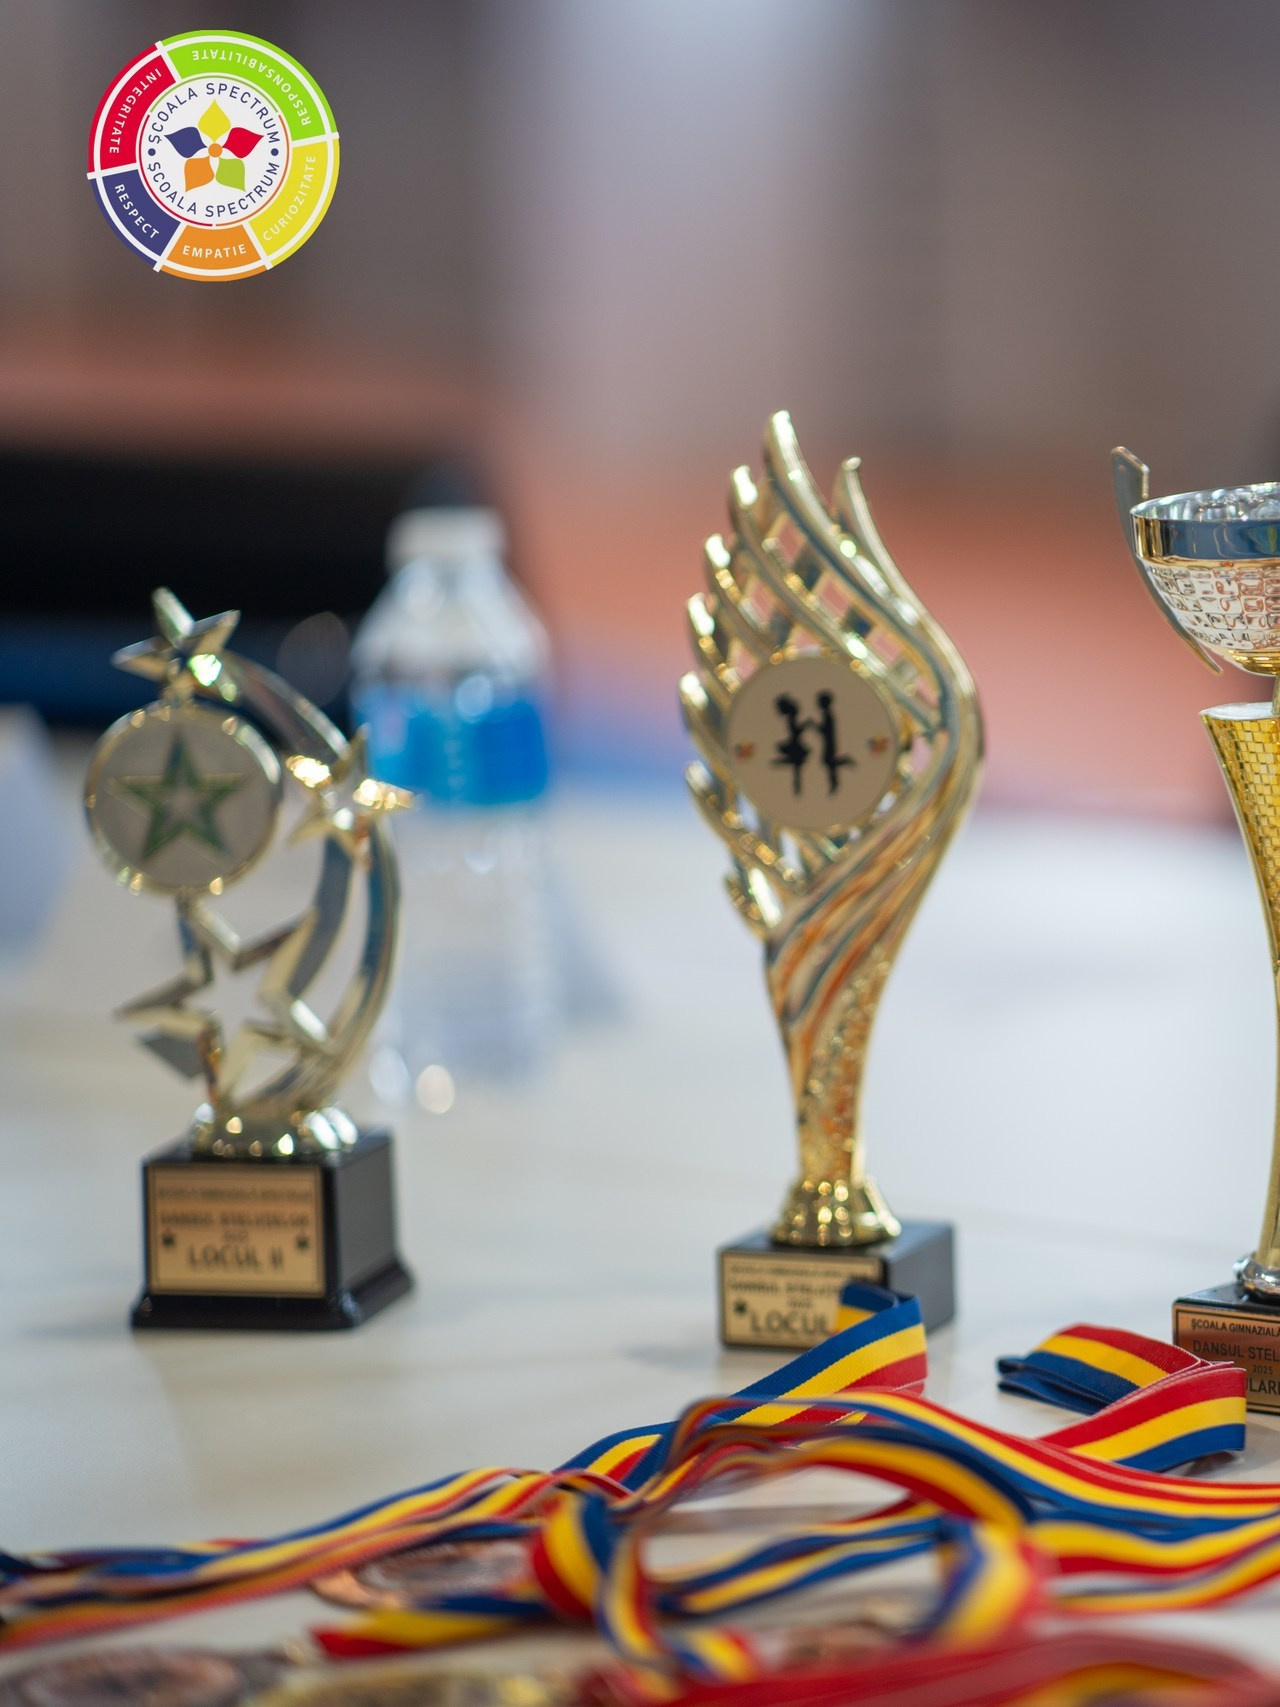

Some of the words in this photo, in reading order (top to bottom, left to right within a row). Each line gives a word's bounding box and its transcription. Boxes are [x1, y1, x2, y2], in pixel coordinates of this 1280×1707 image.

[188, 1244, 261, 1271] LOCUL
[750, 1309, 833, 1337] LOCUL
[1192, 1339, 1244, 1359] DANSUL
[1252, 1364, 1274, 1375] 2025
